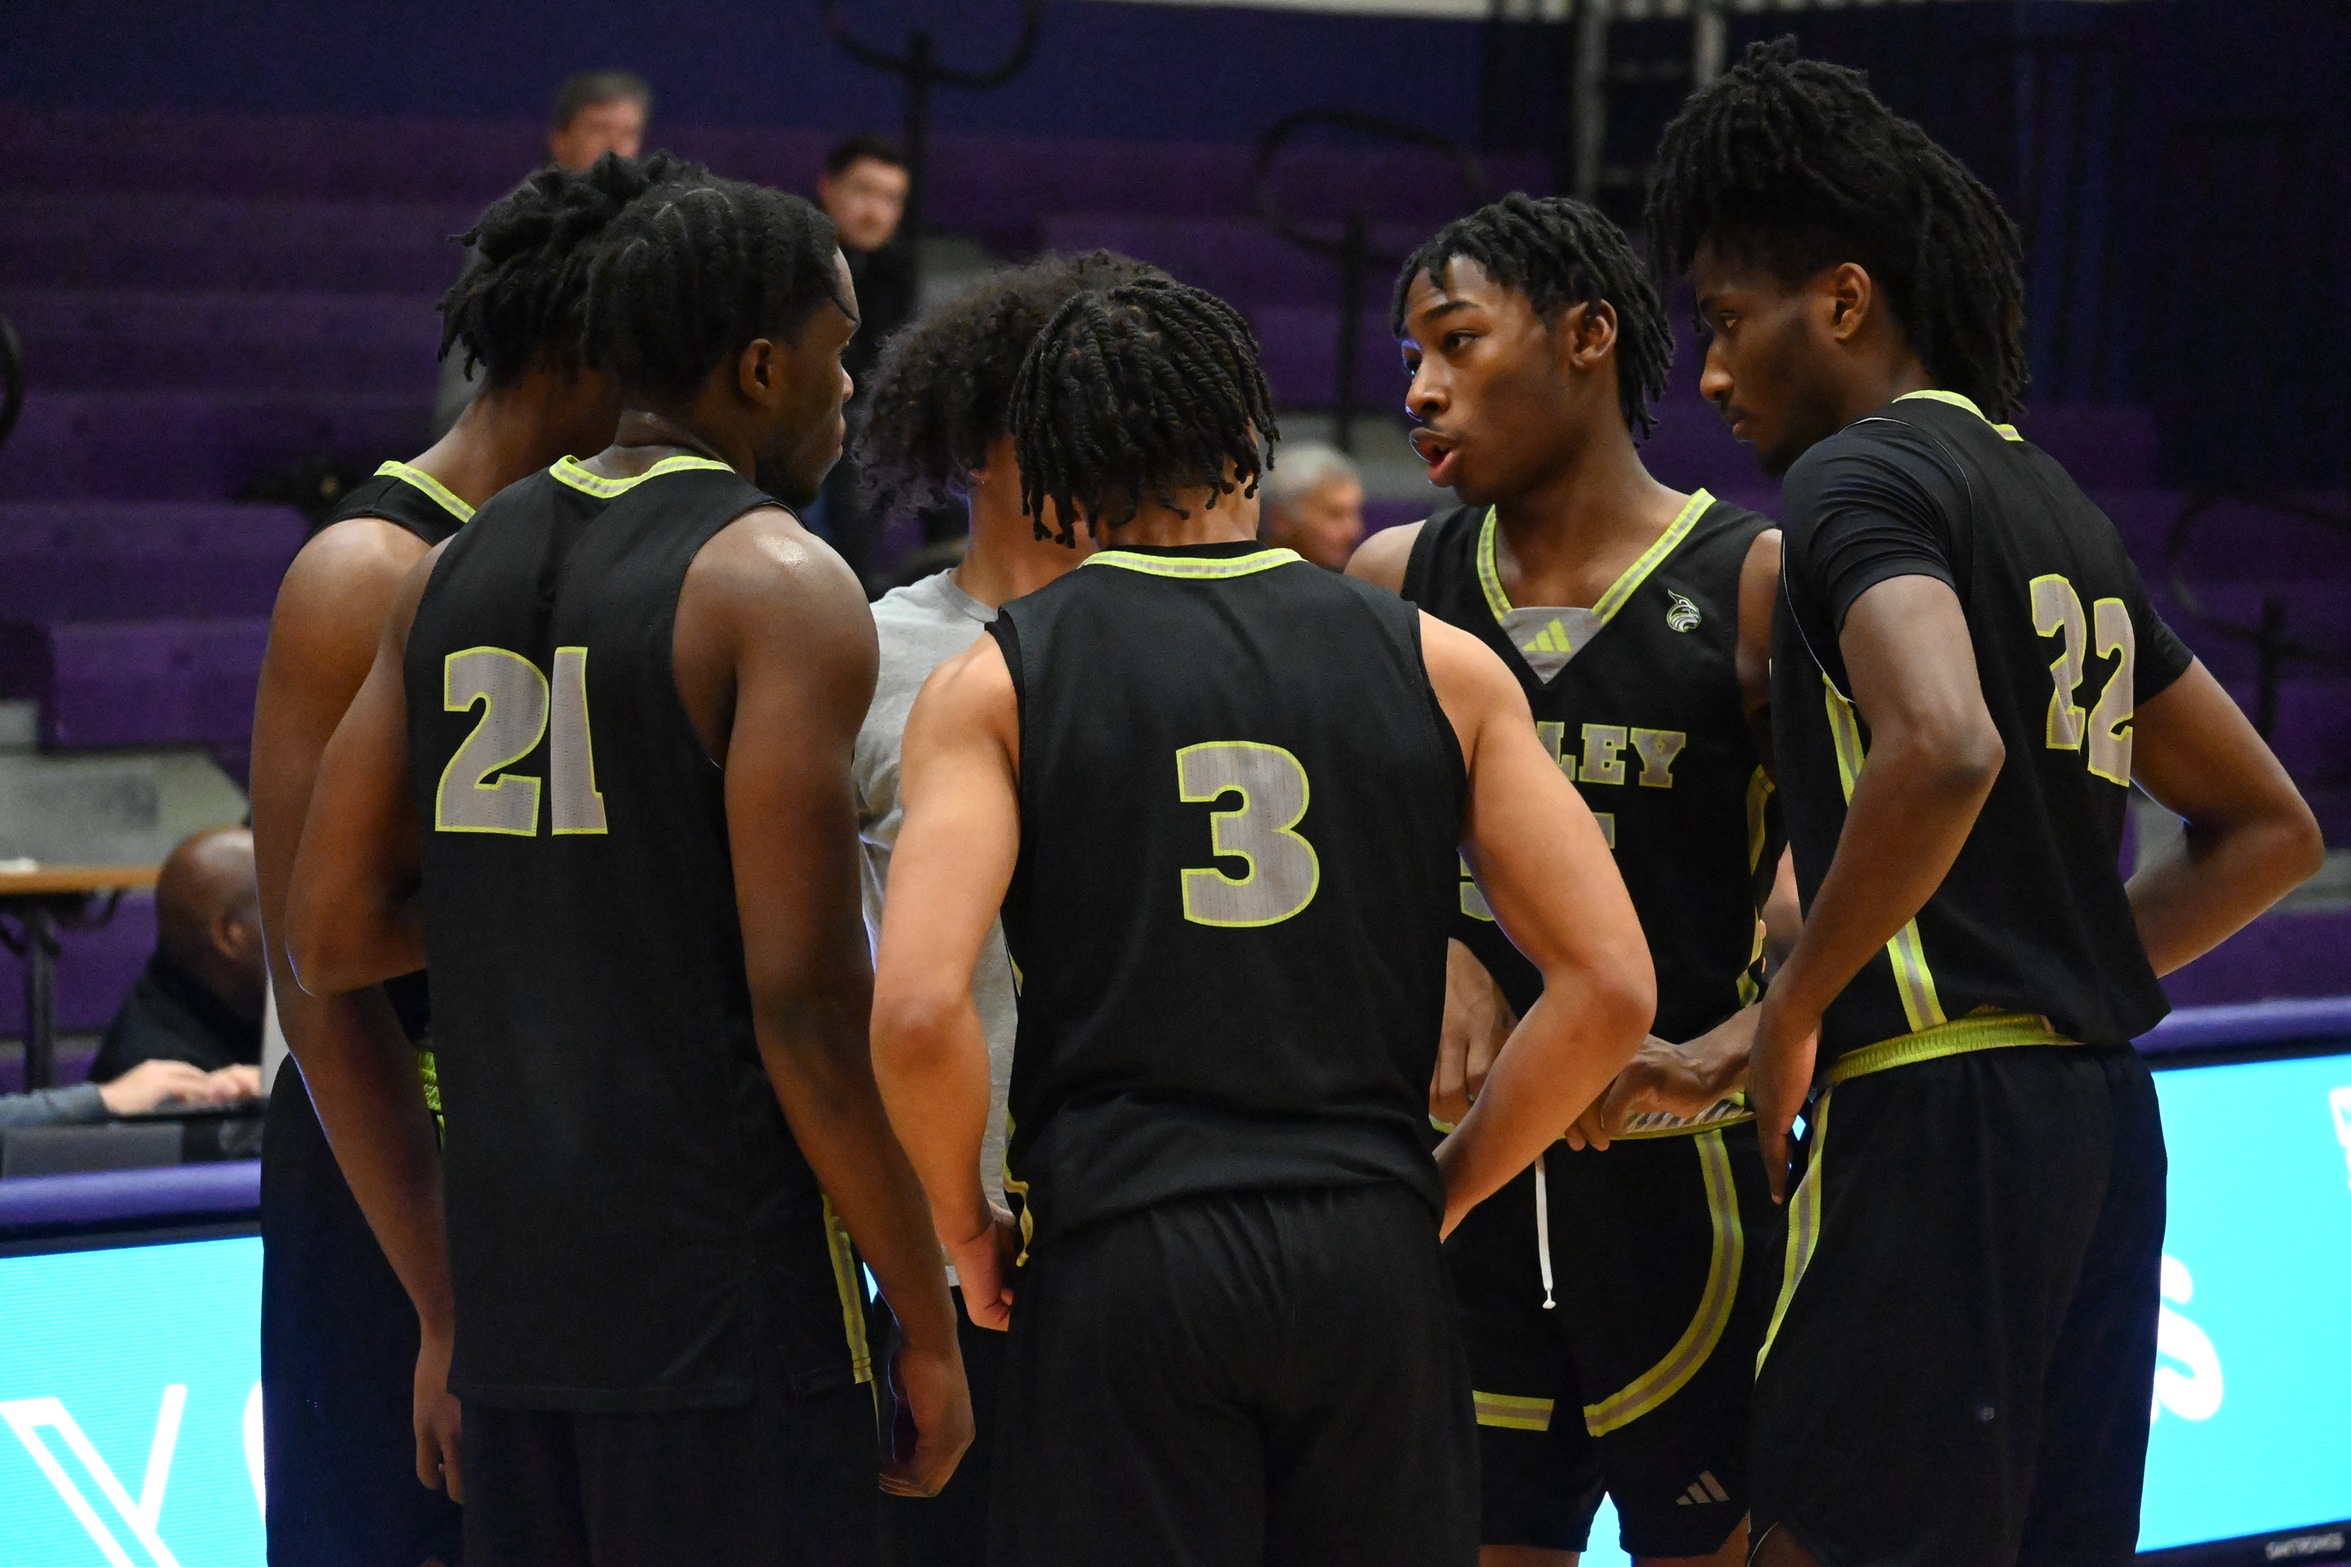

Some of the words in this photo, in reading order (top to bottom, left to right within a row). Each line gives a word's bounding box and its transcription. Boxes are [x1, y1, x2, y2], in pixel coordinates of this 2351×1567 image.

[435, 646, 608, 837] 21
[2029, 573, 2135, 787] 22
[1176, 740, 1320, 928] 3
